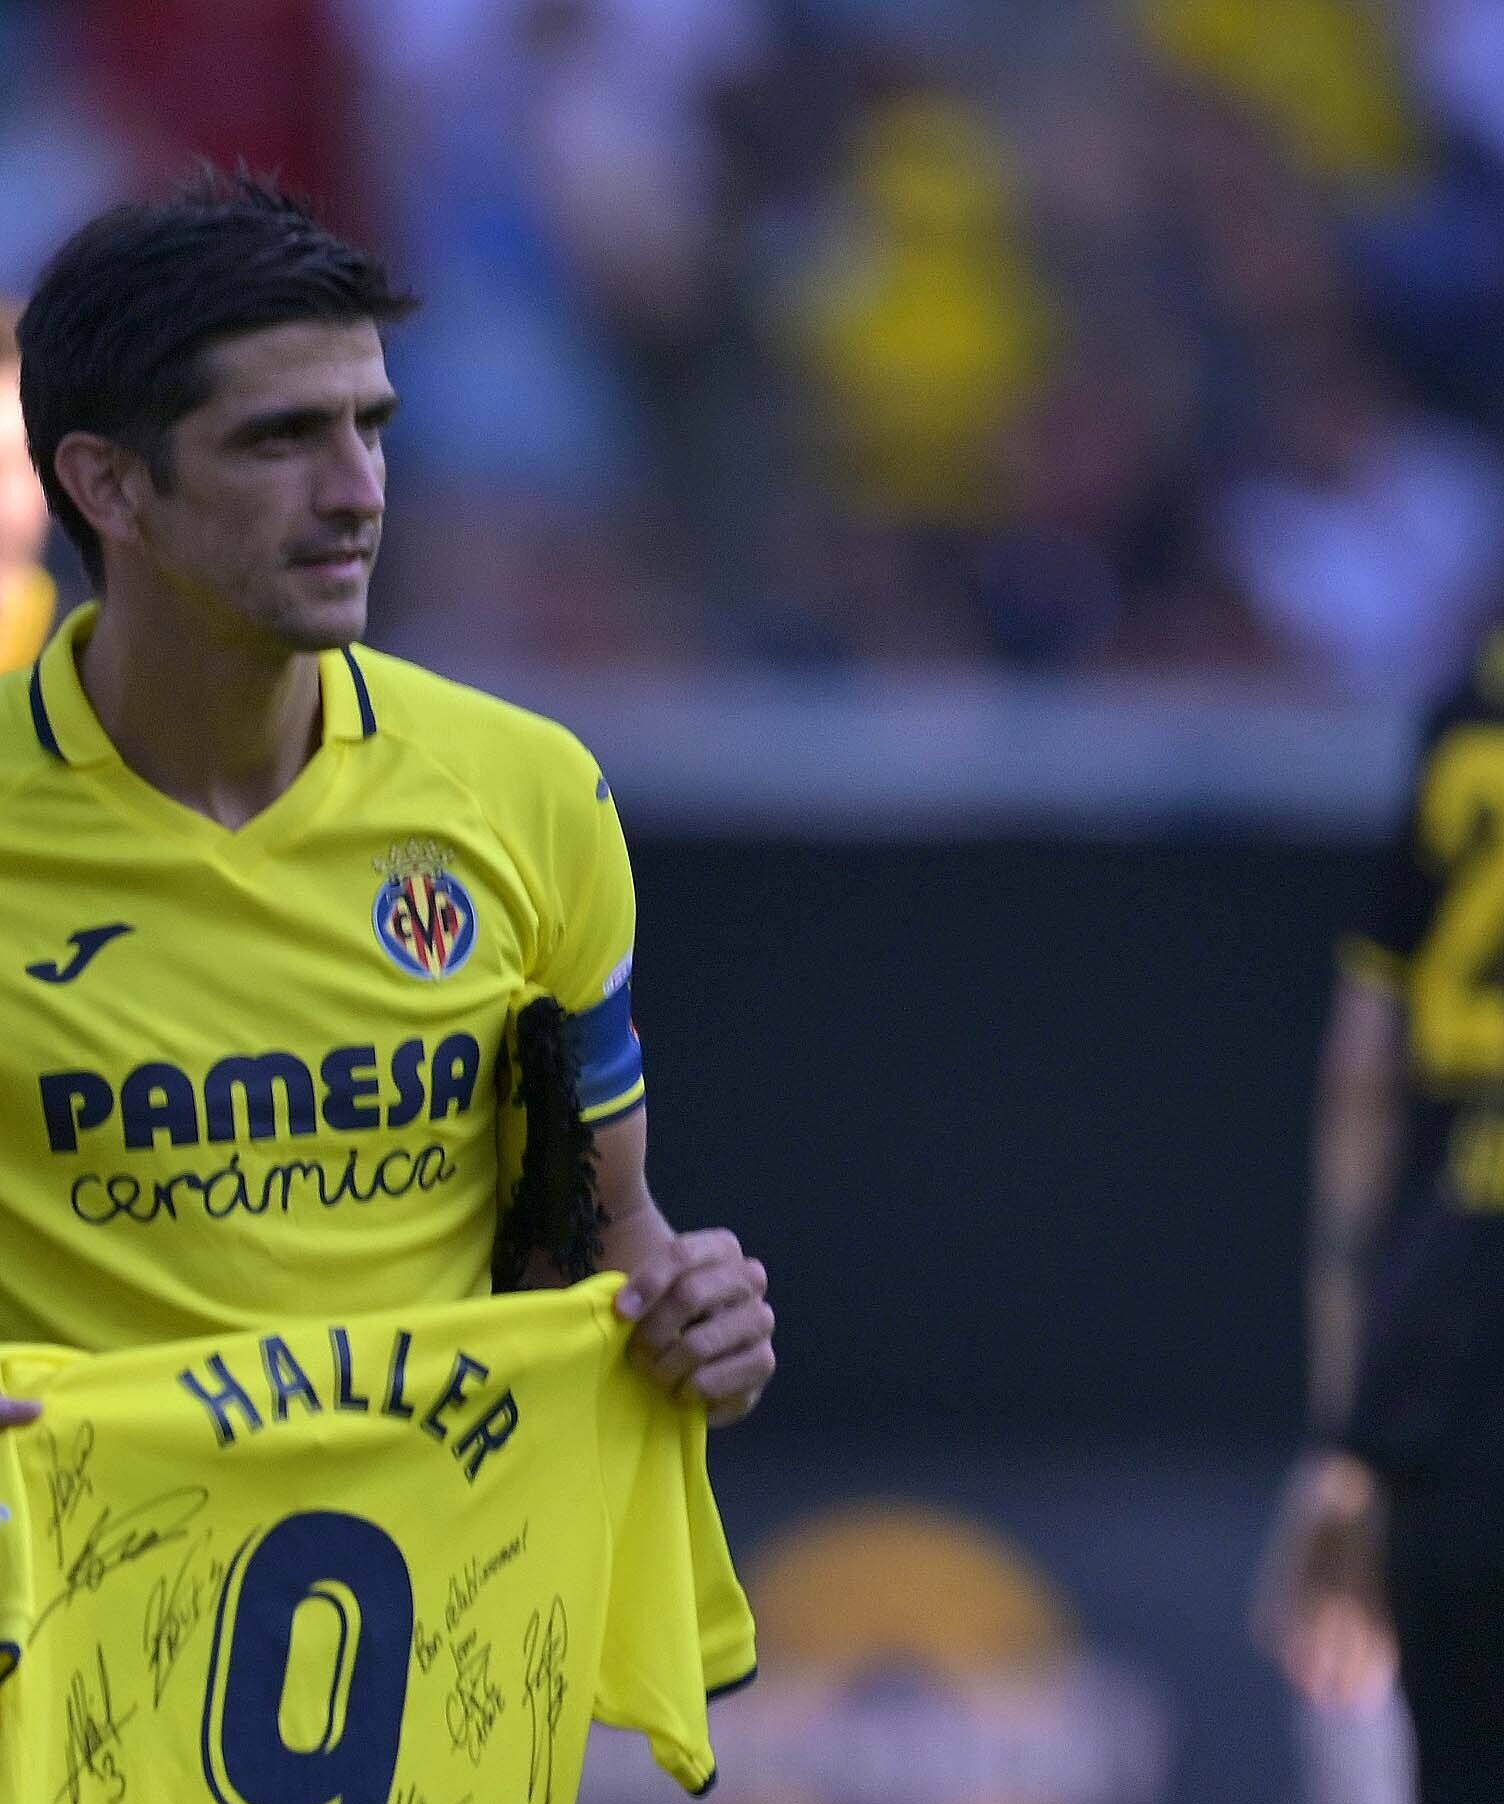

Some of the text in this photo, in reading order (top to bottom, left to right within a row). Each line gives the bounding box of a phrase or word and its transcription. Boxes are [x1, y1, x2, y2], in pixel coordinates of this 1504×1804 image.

[39, 1032, 480, 1153] PAMESA
[71, 1144, 457, 1225] cerámica
[176, 1326, 519, 1487] HALLER
